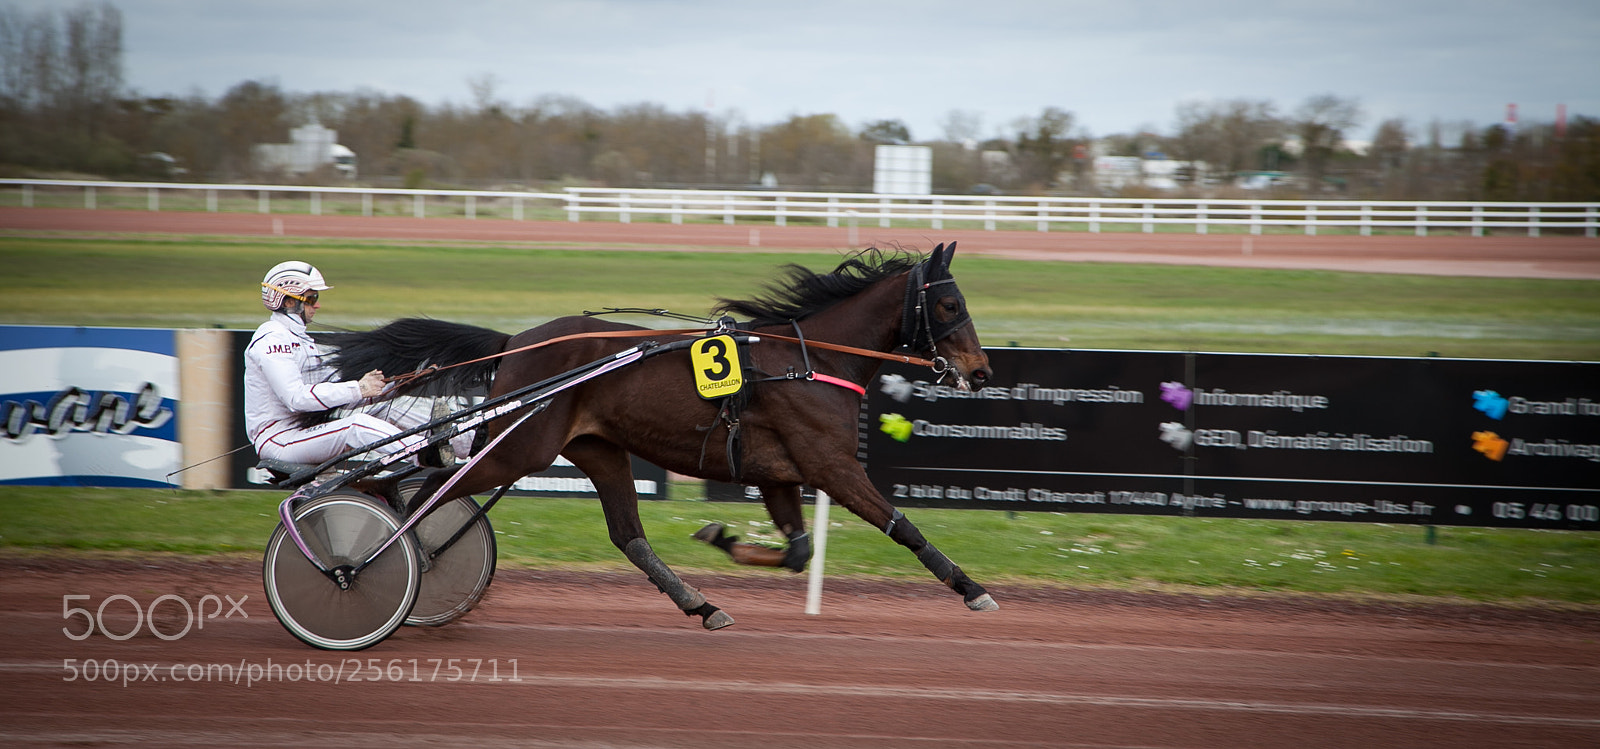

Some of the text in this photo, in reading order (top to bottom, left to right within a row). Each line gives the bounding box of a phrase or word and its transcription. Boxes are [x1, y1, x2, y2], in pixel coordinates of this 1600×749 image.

[701, 339, 731, 380] 3
[699, 379, 741, 392] CHATELAILLON
[1193, 388, 1328, 412] Informatique
[1508, 396, 1575, 416] Grand
[912, 419, 1067, 441] Consommables
[1248, 430, 1433, 453] Dématérialisation
[892, 483, 908, 498] 2
[944, 487, 972, 501] du
[1027, 489, 1106, 505] Charcot
[1109, 491, 1168, 508] 17440
[1492, 502, 1530, 519] 05
